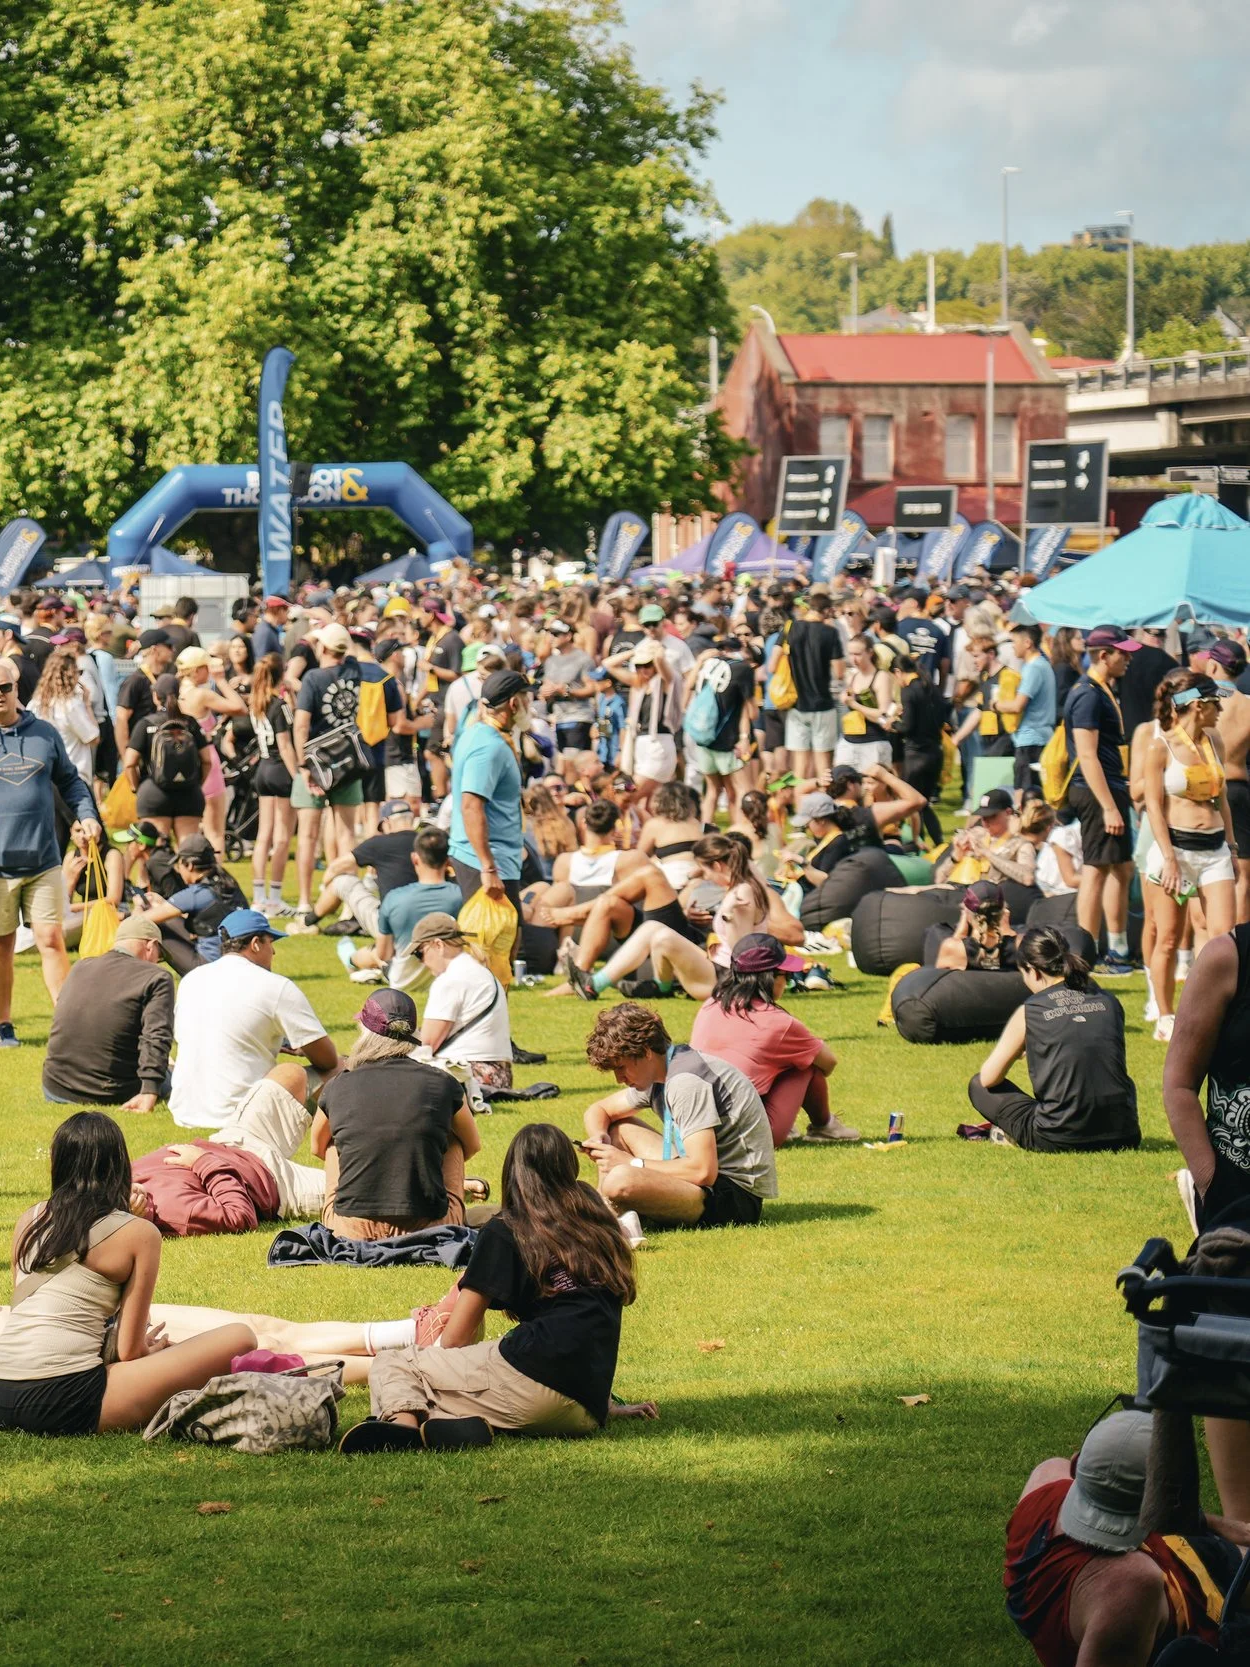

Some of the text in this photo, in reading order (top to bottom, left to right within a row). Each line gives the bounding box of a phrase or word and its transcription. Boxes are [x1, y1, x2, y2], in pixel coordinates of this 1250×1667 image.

[221, 485, 342, 505] THOON
[1055, 997, 1085, 1006] STOP
[1043, 1002, 1106, 1021] EXPLORING
